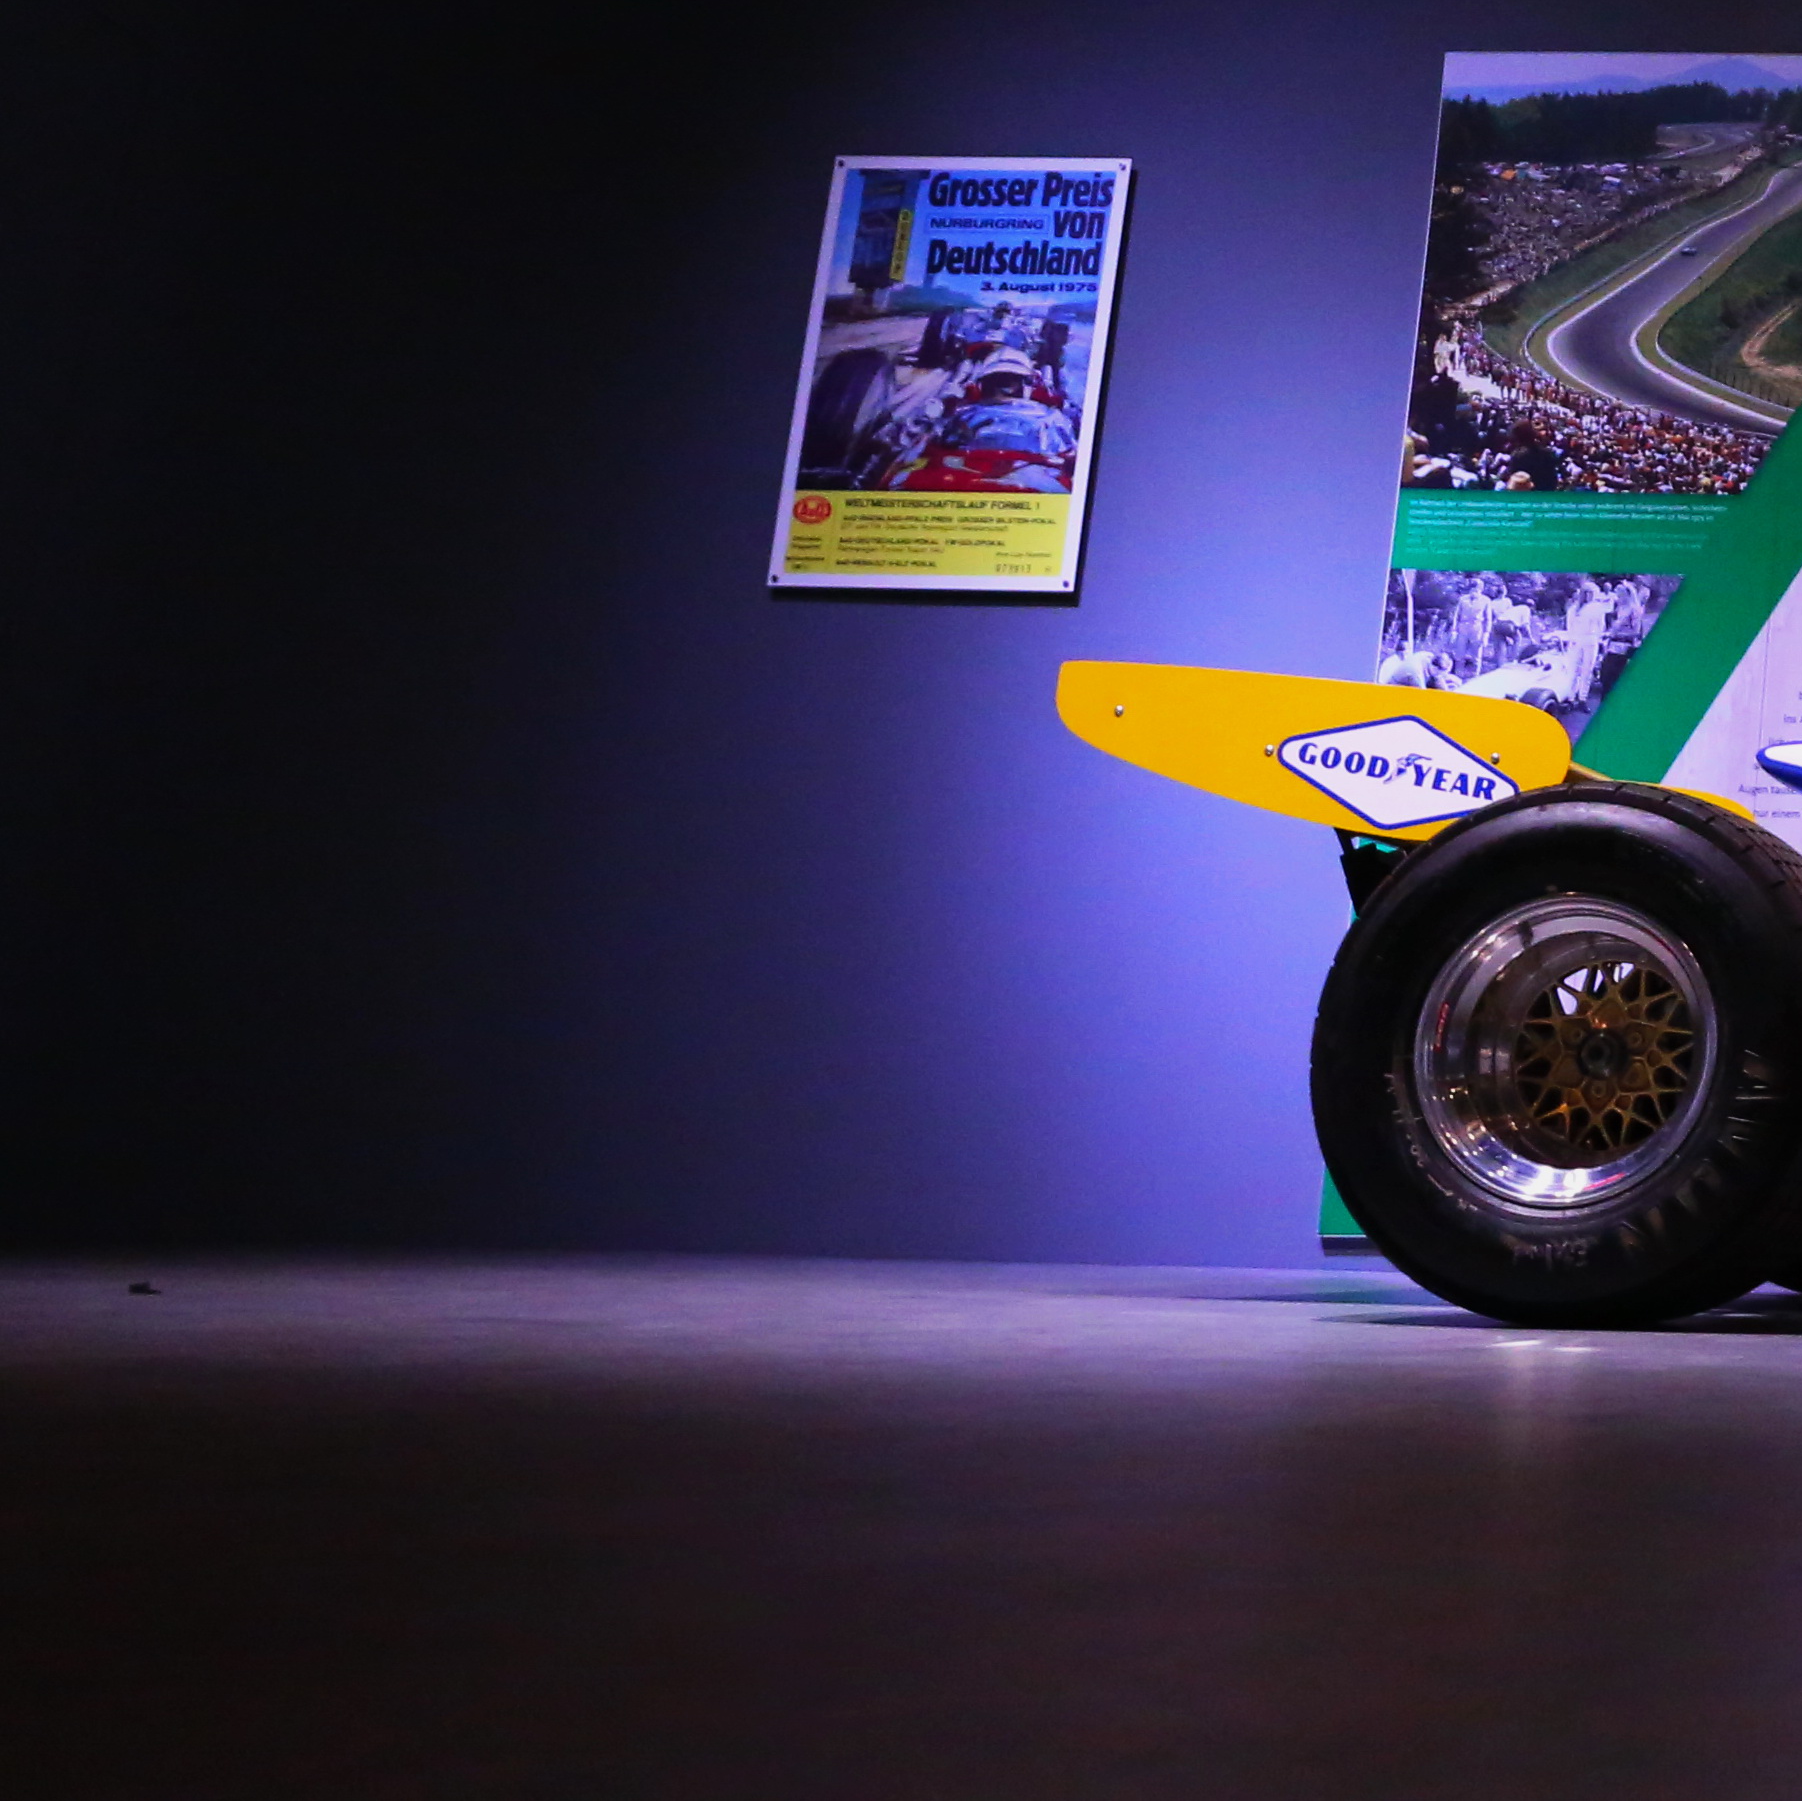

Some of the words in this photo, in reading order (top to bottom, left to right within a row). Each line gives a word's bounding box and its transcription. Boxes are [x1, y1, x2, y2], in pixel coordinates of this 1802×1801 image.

[928, 172, 1039, 207] Grosser
[1042, 171, 1115, 207] Preis
[1054, 210, 1105, 239] von
[927, 239, 1102, 275] Deutschland
[979, 280, 995, 291] 3.
[997, 281, 1055, 294] August
